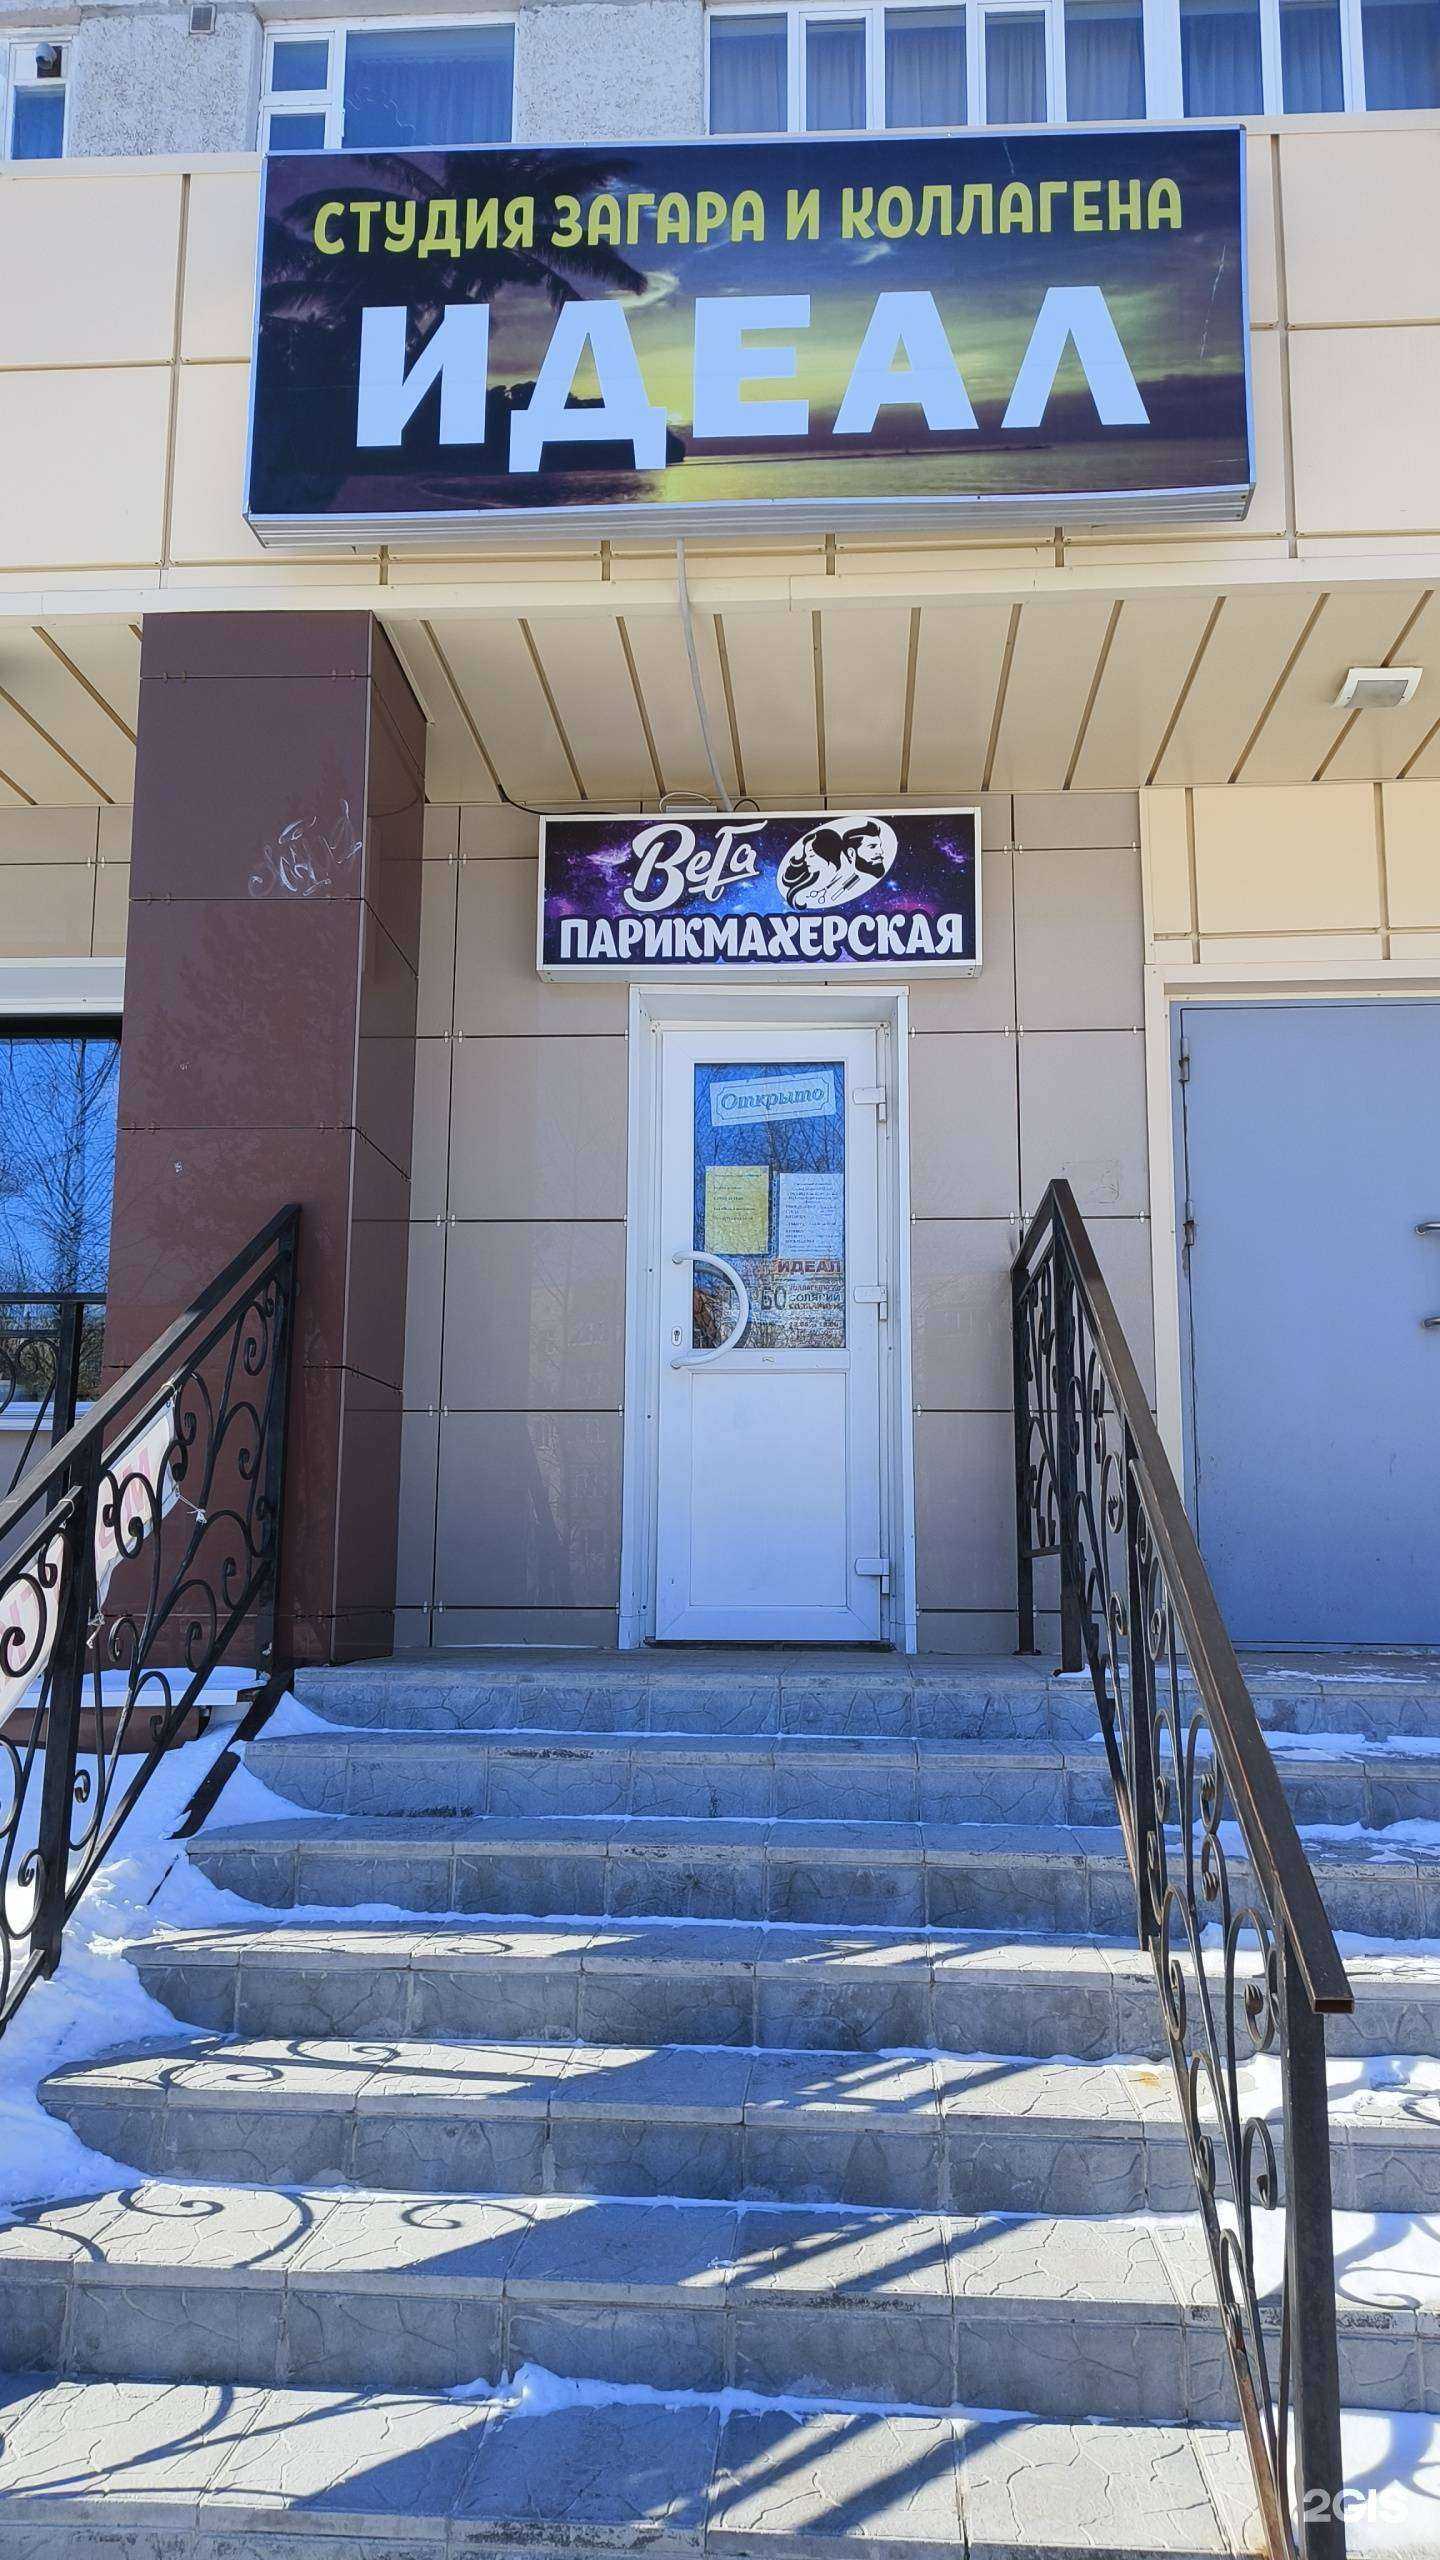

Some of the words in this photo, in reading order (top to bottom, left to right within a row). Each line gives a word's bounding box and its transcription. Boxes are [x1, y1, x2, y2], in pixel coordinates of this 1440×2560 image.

[314, 196, 534, 258] СТУДИЯ
[551, 190, 763, 248] ЗАГАРА
[786, 190, 818, 240] И
[841, 179, 1181, 240] КОЛЛАГЕНА
[356, 285, 1151, 473] ИДЕАЛ
[560, 913, 963, 959] ПАРИКМАХЕРСКАЯ
[721, 1088, 825, 1110] Открыто
[777, 1260, 841, 1275] ИДЕАЛ
